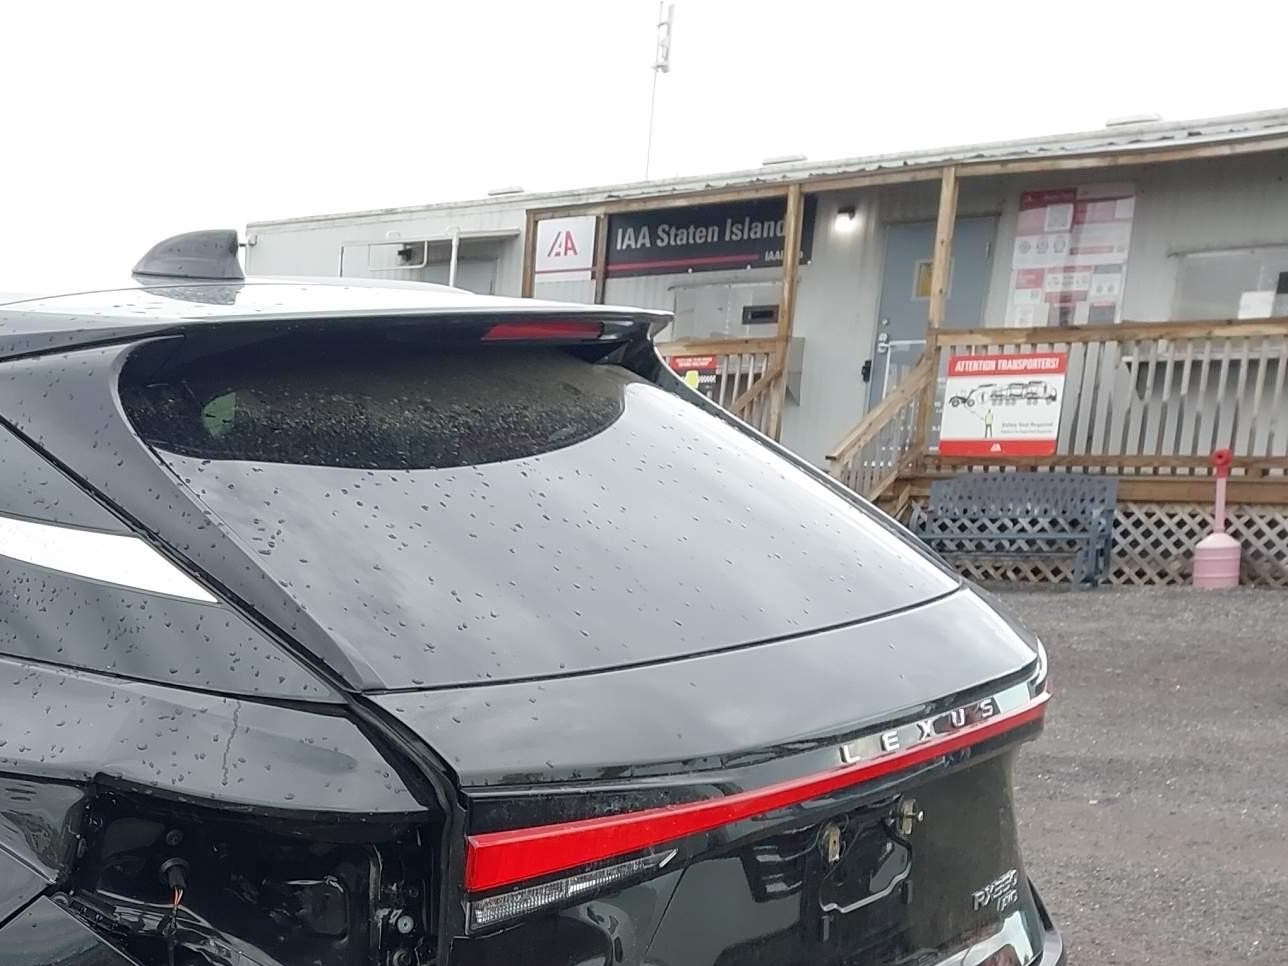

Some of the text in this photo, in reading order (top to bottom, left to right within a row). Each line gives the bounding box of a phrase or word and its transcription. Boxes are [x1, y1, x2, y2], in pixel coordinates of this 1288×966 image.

[616, 226, 650, 250] IAA
[657, 223, 719, 247] Staten
[955, 358, 1059, 372] ATTENTION TRANSPORTERS!
[840, 698, 994, 765] LEXUS
